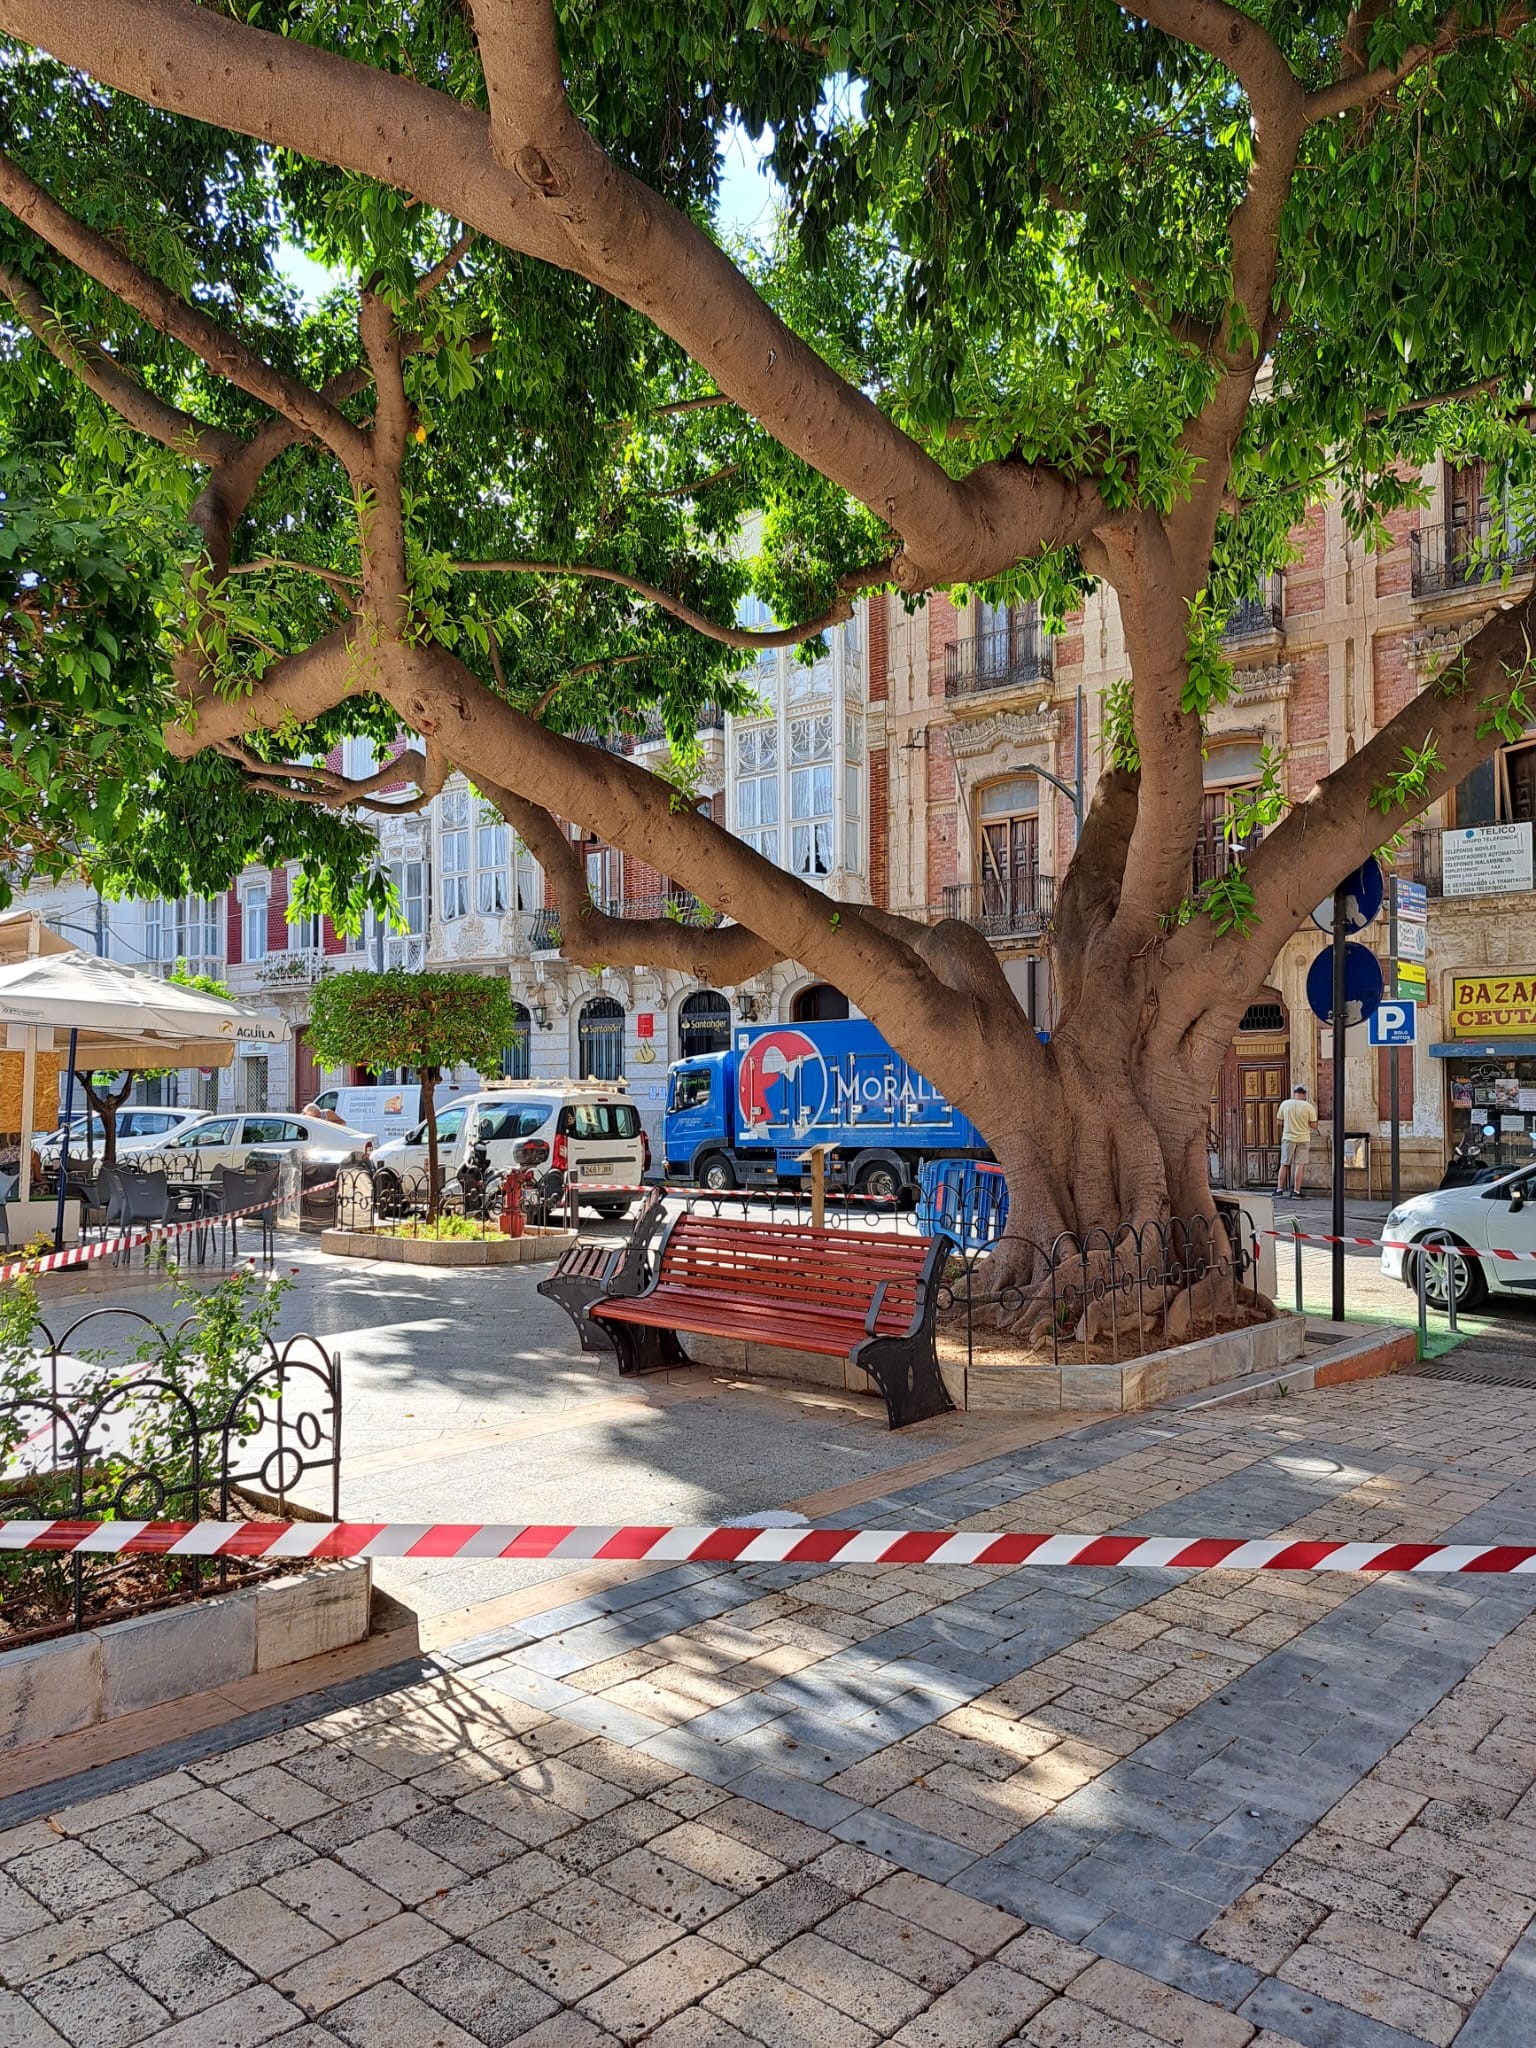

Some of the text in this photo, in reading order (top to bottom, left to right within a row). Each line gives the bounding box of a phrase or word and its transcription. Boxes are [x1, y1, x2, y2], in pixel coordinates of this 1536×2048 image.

[1480, 826, 1516, 835] TELICO
[1444, 853, 1487, 862] CONTESTADORES
[690, 1020, 728, 1031] Santander
[1378, 1006, 1405, 1040] P
[589, 1024, 622, 1033] Santander
